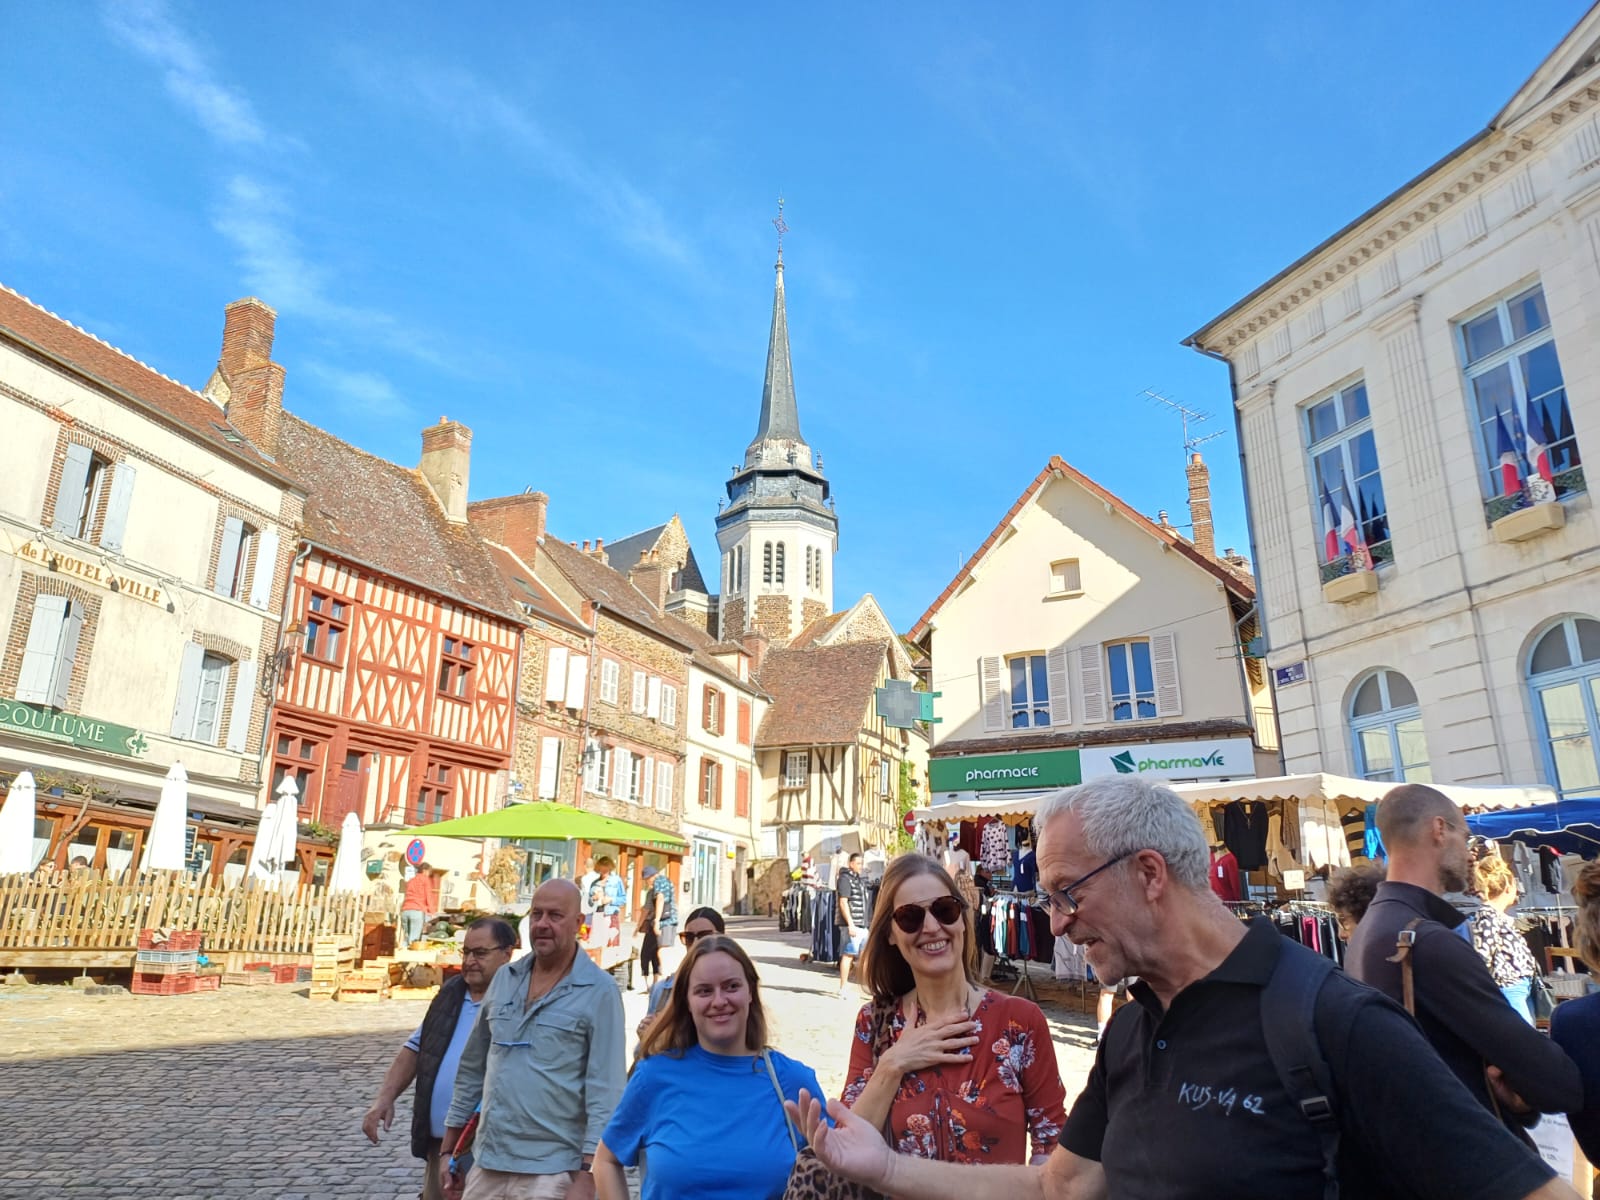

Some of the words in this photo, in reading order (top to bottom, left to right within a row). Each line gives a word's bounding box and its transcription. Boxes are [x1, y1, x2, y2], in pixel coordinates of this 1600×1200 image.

[21, 542, 37, 558] de
[117, 575, 162, 603] VILLE
[1242, 1093, 1265, 1115] 62
